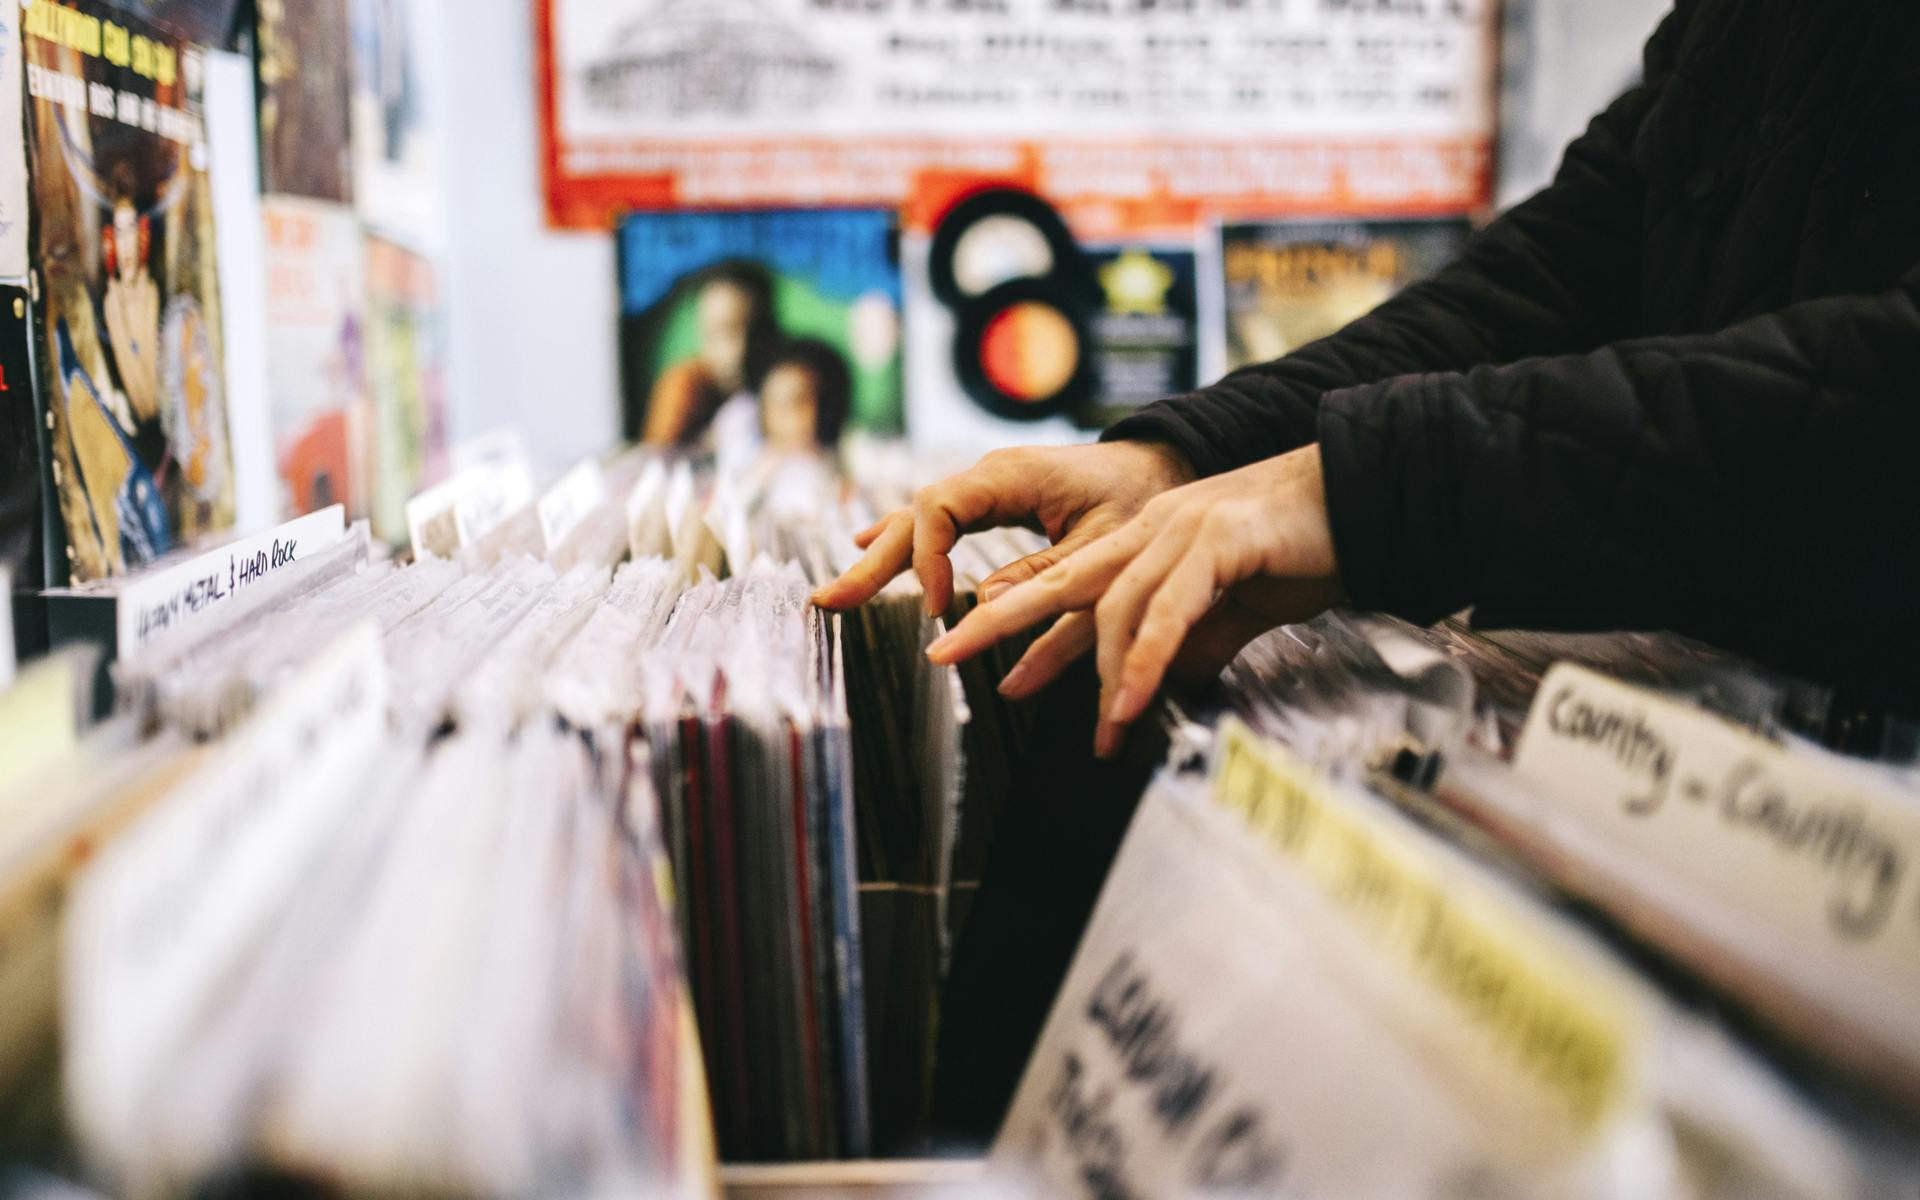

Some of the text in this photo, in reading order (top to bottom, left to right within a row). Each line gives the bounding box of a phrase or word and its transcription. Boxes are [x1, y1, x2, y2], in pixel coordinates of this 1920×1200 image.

[239, 549, 268, 586] HARD
[271, 538, 297, 569] ROCK
[1546, 685, 1675, 818] Country
[1716, 750, 1907, 946] Country
